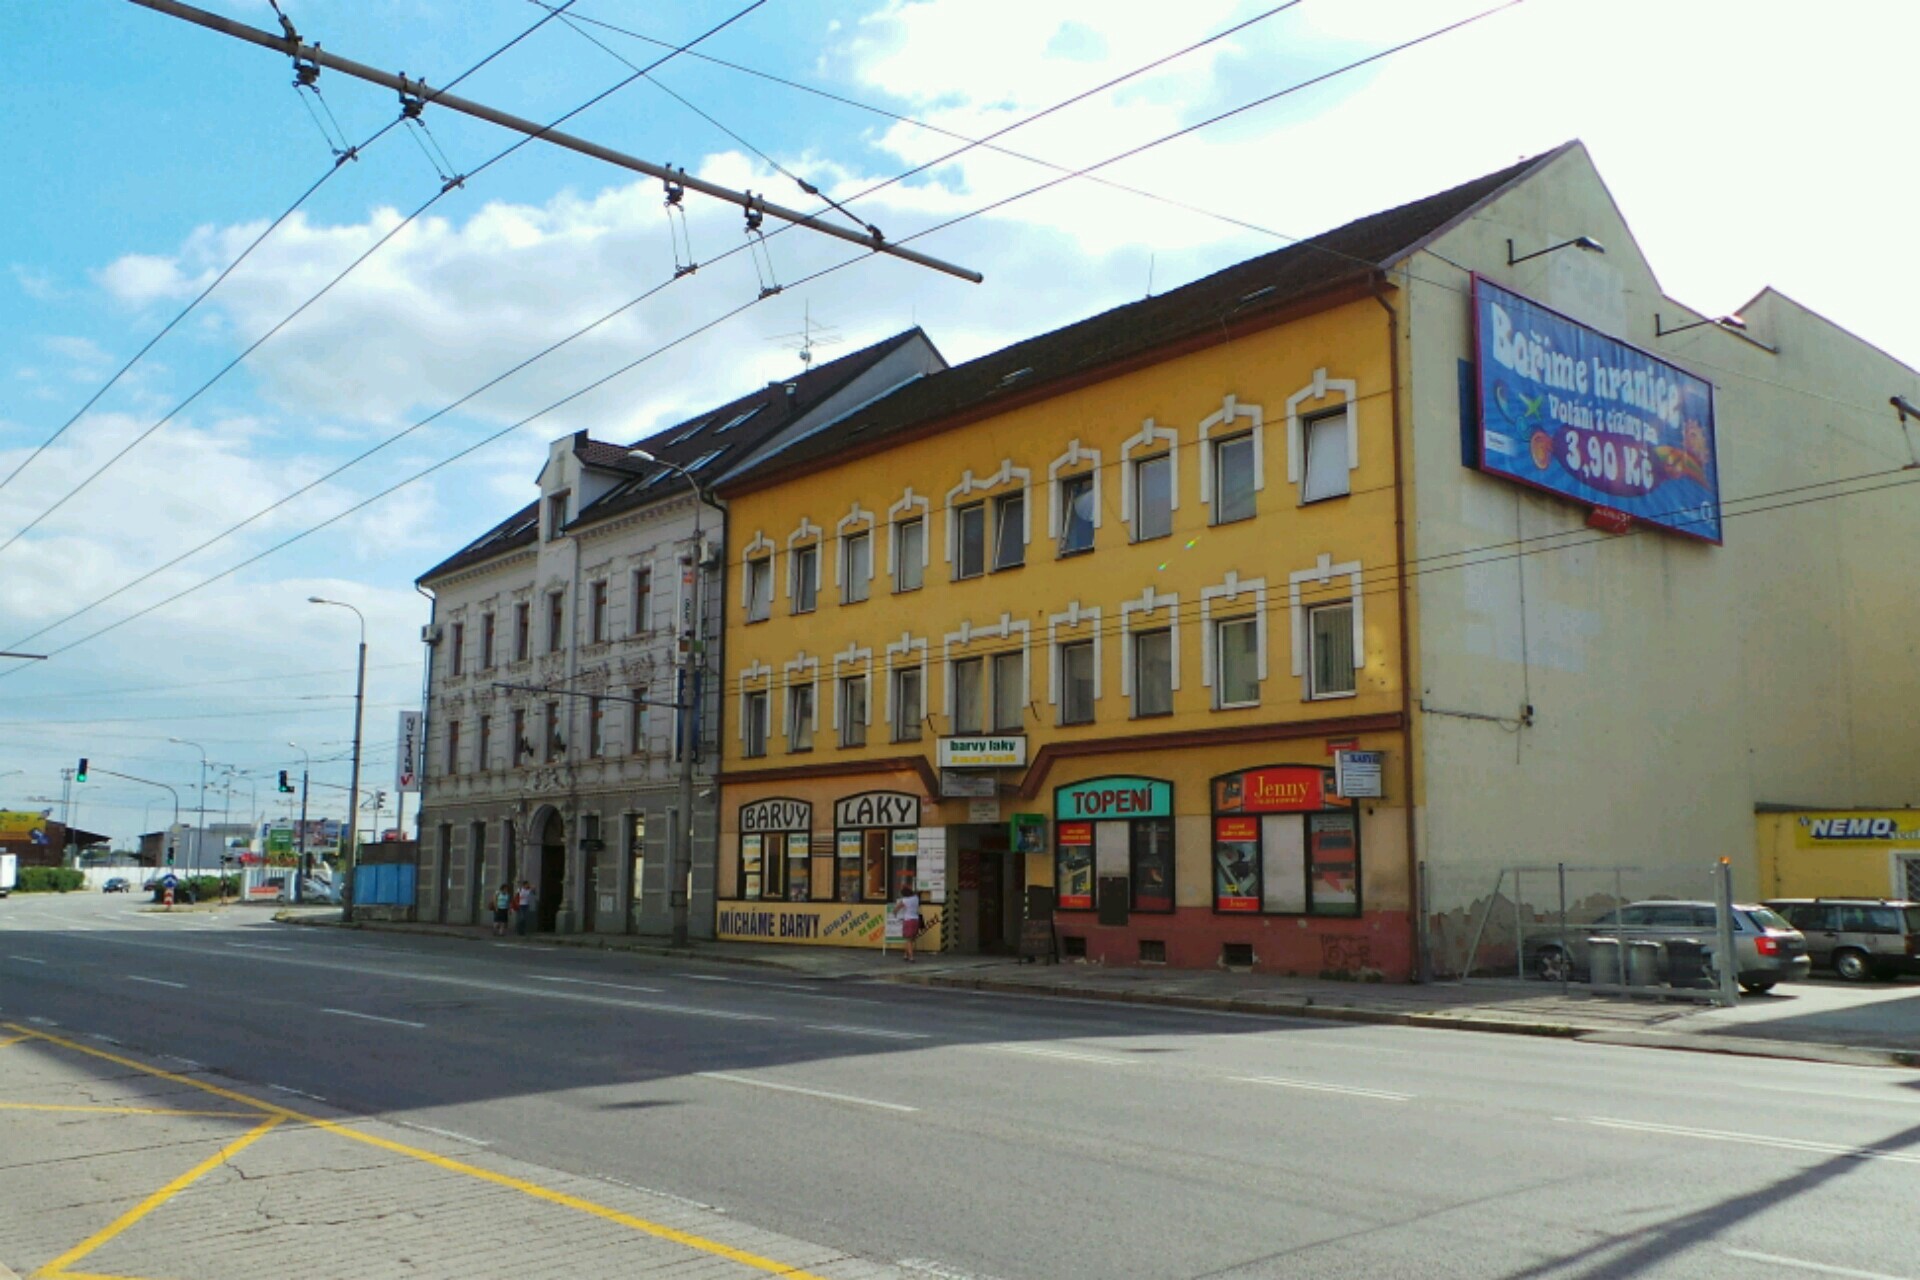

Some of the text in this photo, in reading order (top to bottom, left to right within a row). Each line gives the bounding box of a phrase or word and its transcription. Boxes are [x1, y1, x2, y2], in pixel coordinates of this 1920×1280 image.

[1491, 302, 1681, 429] Boříme hranice
[1548, 393, 1594, 431] Volání
[1565, 430, 1655, 491] 3,90 Kč
[949, 739, 1016, 752] barvy laky
[1071, 781, 1153, 815] TOPENÍ
[1253, 775, 1309, 803] Jenny
[744, 802, 808, 830] BARVY
[842, 796, 913, 825] LAKY
[1811, 817, 1895, 839] NEMO
[718, 905, 776, 937] MÍCHÁME
[779, 913, 821, 939] BARVY
